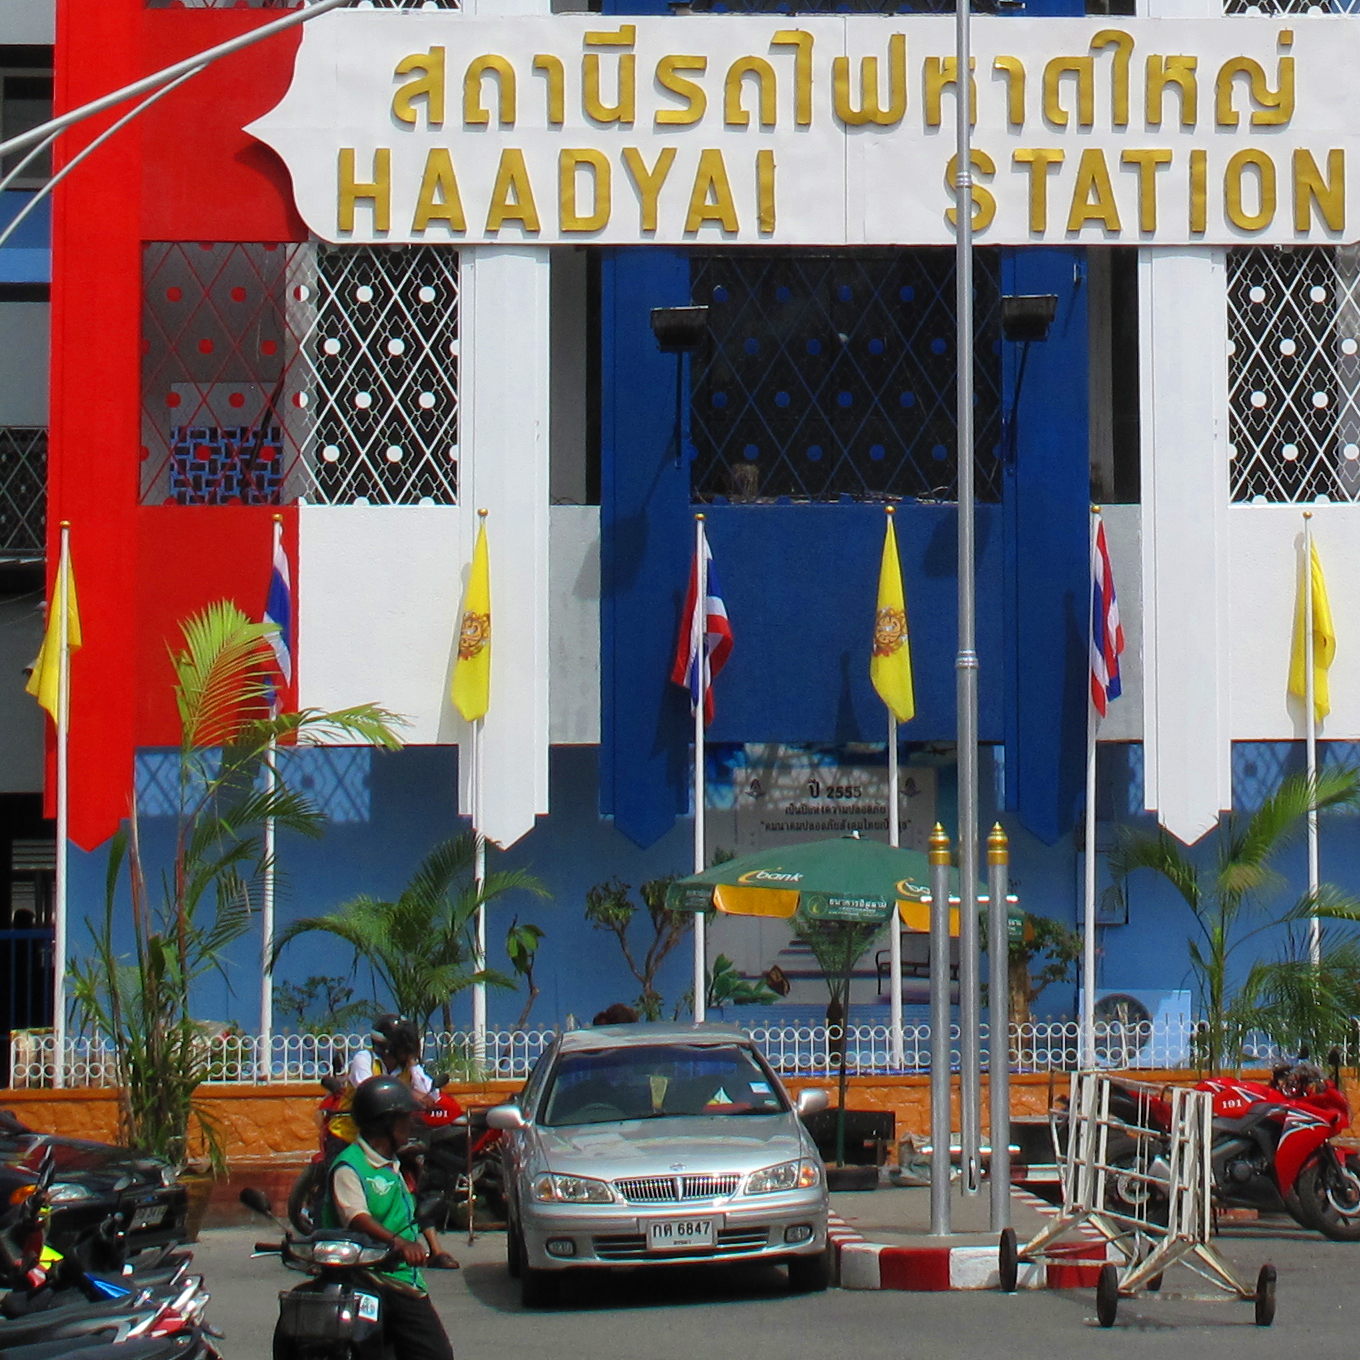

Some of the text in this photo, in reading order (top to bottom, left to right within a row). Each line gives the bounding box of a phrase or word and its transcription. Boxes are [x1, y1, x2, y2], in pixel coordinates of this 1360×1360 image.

[392, 24, 1295, 126] สถานีรถไฟหาดใหญ่
[337, 147, 1346, 233] HAADYAI STATION
[826, 786, 862, 799] 2555
[678, 1221, 710, 1236] 6847
